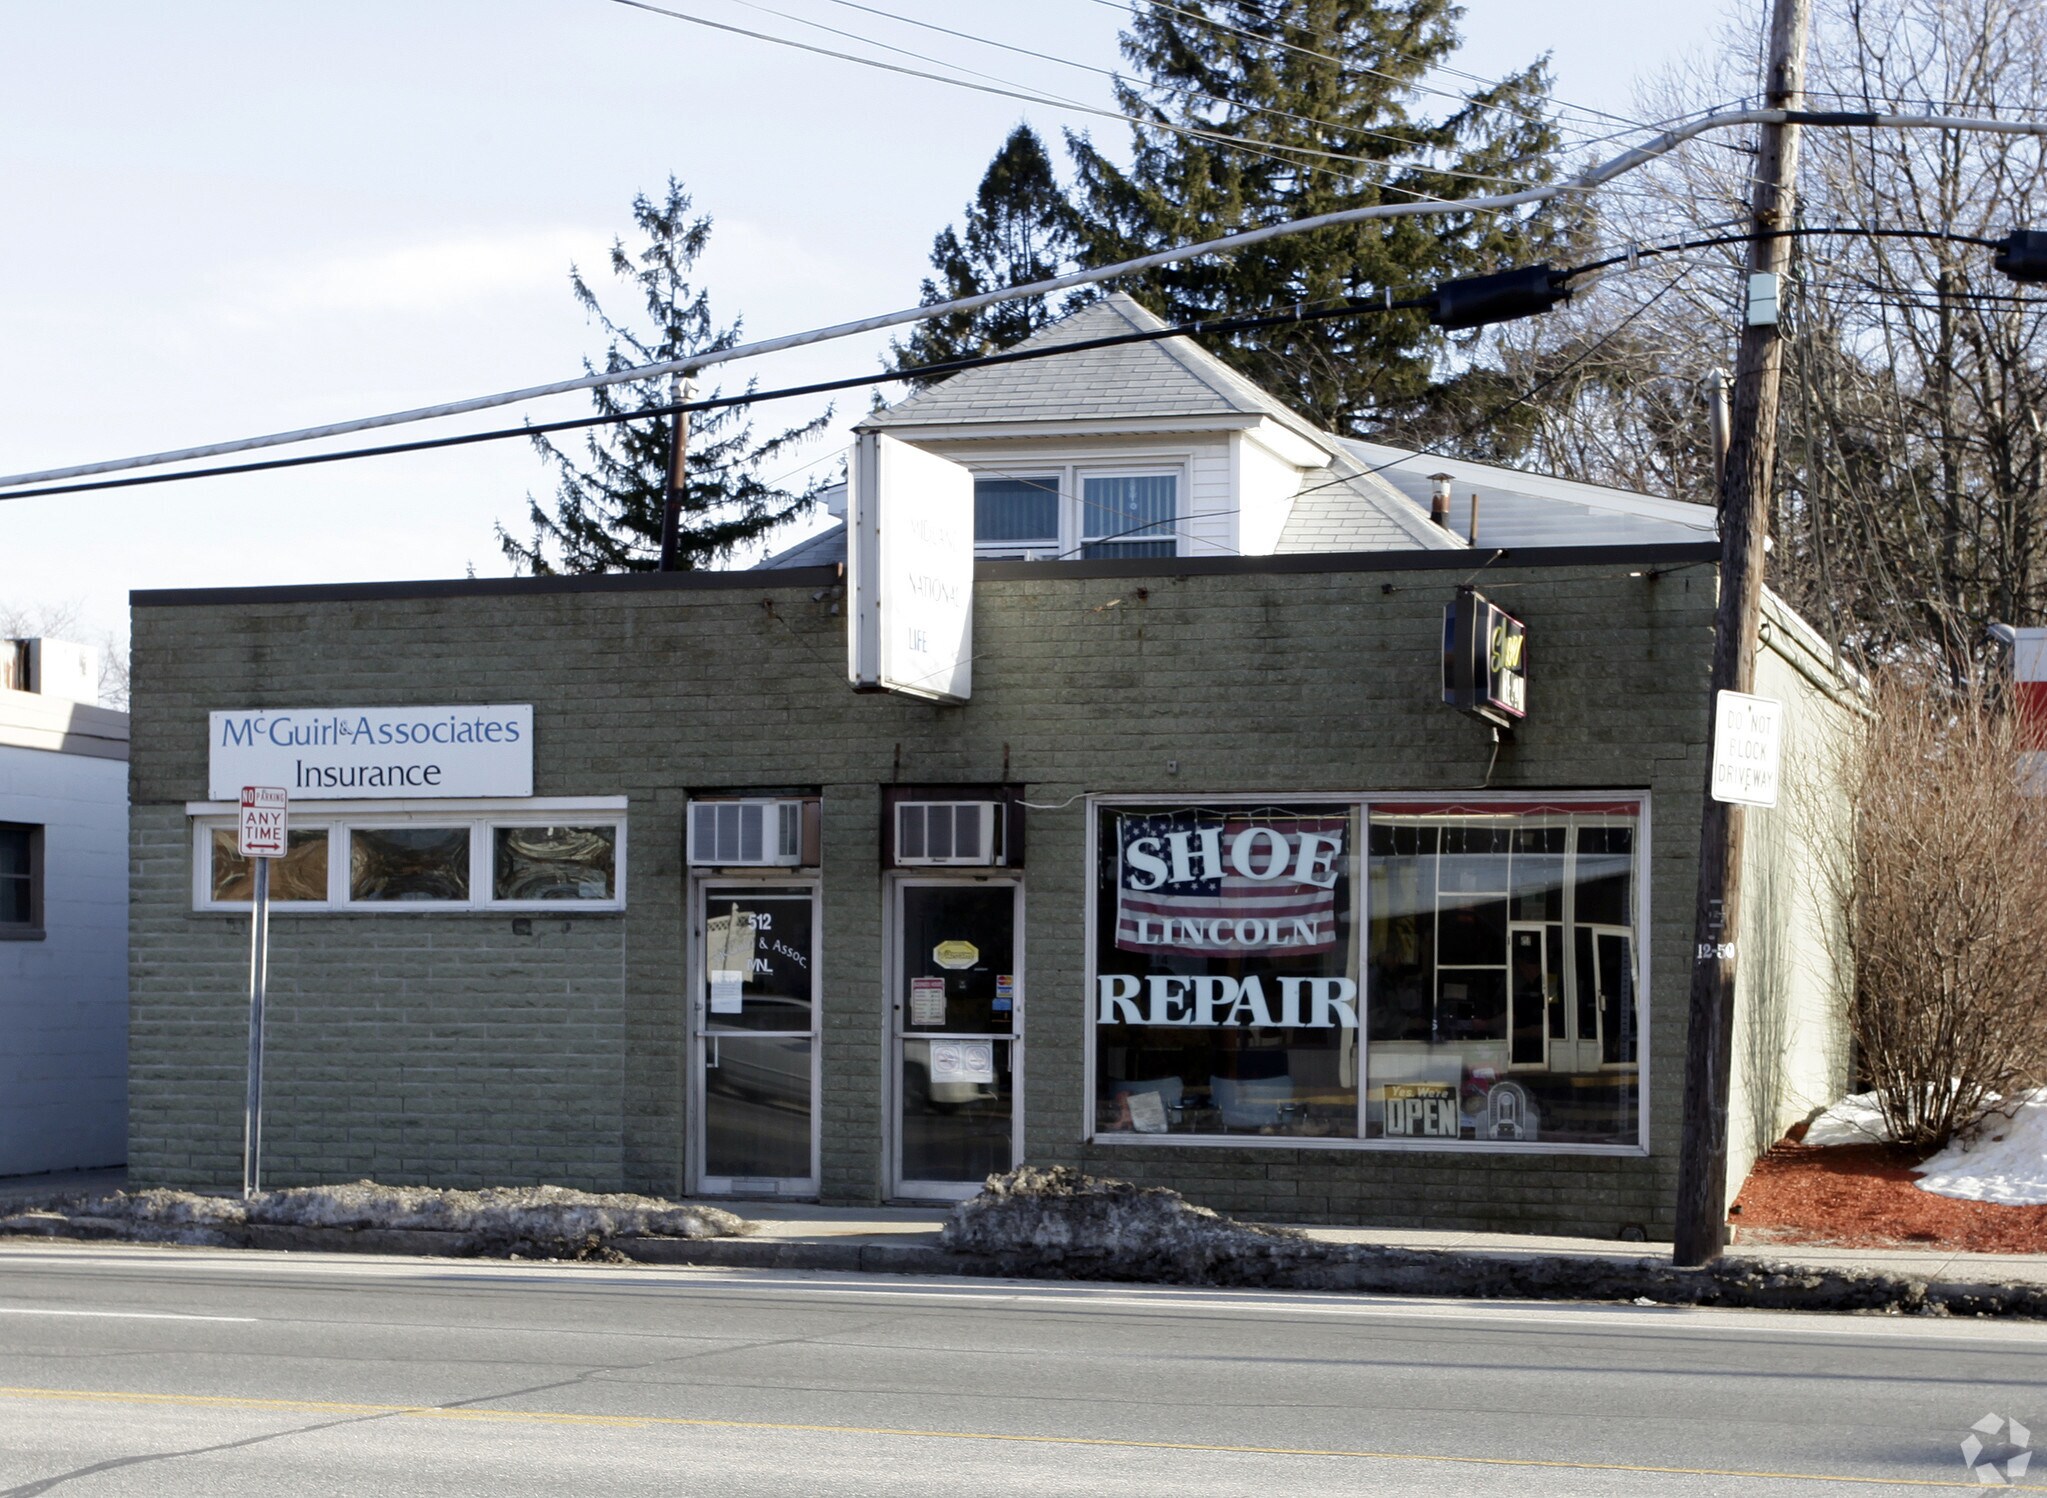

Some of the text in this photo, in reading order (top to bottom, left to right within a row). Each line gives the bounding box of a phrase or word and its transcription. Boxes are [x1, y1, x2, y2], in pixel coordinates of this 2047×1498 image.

[908, 626, 928, 653] LIFE
[352, 714, 520, 745] Associates
[1727, 710, 1771, 734] DO NOT
[1729, 737, 1767, 760] BLOCK
[295, 758, 441, 788] Insurance
[1718, 763, 1773, 788] DRIVEWAY
[242, 789, 284, 803] NO PARKING
[246, 811, 281, 825] ANY
[245, 826, 281, 840] TIME
[1126, 826, 1343, 891] SHOE
[747, 913, 772, 930] 512
[1135, 917, 1321, 946] LINCOLN
[759, 937, 768, 950] &
[1696, 942, 1735, 960] 12-50
[1097, 974, 1359, 1028] REPAIR
[1387, 1098, 1456, 1137] OPEN
